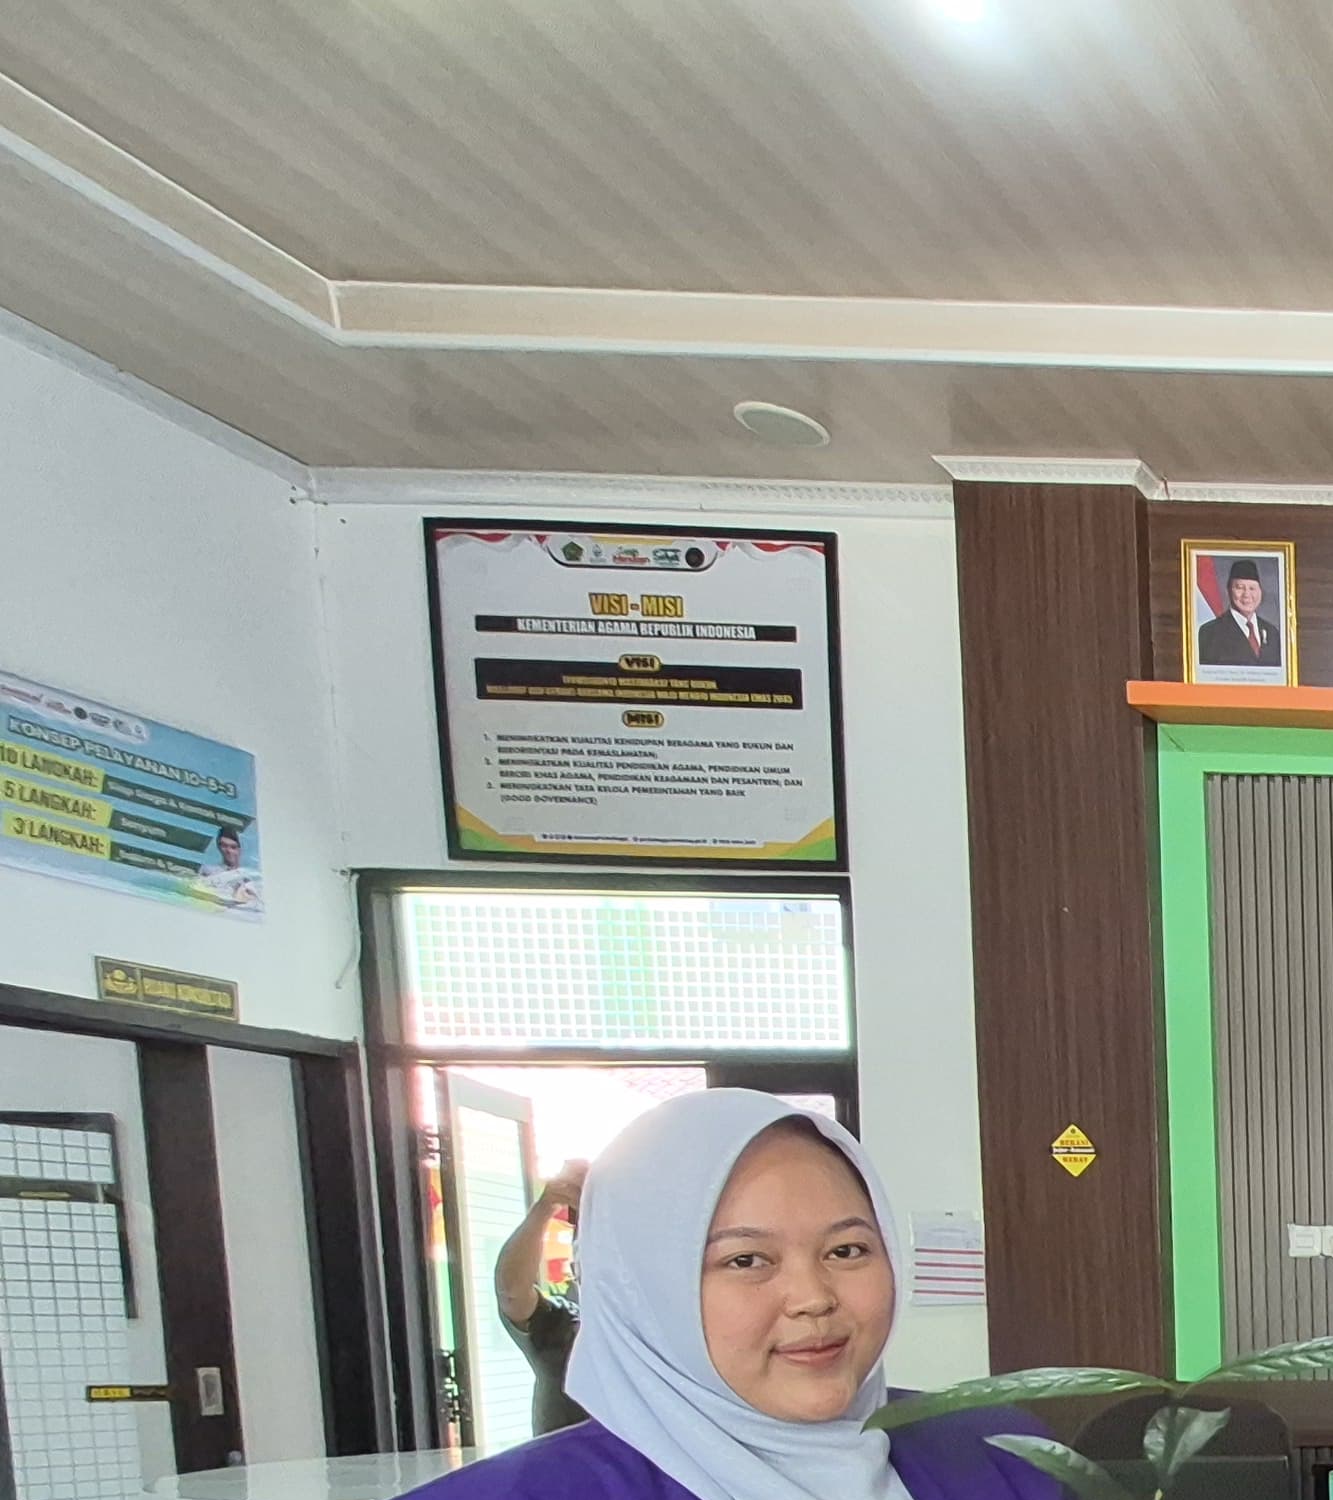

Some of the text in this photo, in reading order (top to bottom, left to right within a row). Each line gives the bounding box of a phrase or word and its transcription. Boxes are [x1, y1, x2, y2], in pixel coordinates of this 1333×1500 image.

[589, 592, 628, 616] VISI
[641, 594, 684, 617] MISI
[516, 618, 757, 640] KEMENTERIAN AGAMA REPUBLIK INDONESIA
[9, 716, 81, 750] KONSEP
[83, 741, 181, 781] PELAYANAN
[4, 780, 15, 798] 5
[13, 817, 25, 835] 3
